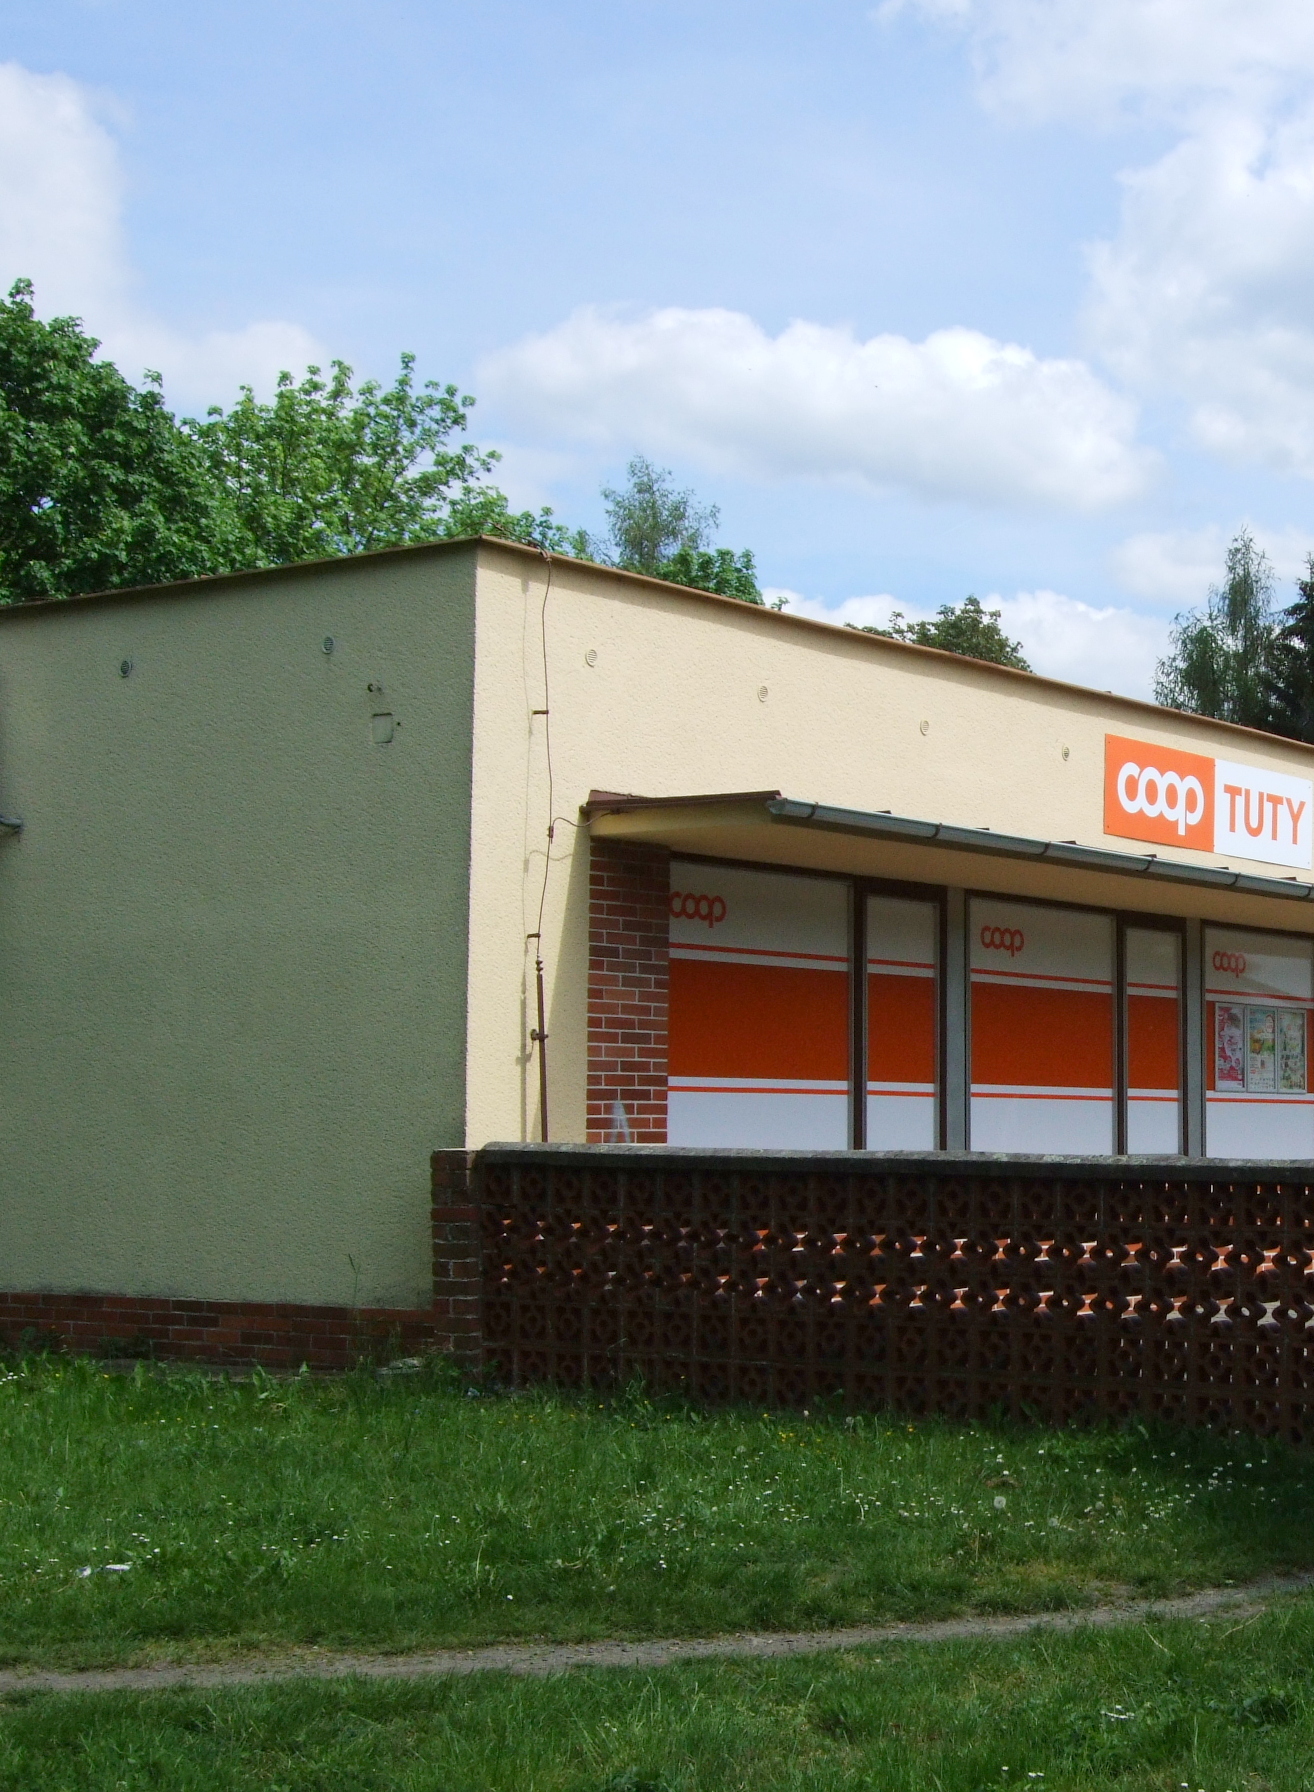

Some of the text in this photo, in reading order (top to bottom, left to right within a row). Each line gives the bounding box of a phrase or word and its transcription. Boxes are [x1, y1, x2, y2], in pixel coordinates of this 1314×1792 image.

[1117, 761, 1306, 845] coop TUTY
[669, 891, 727, 928] coop
[981, 925, 1025, 957] coop
[1212, 950, 1246, 978] coop
